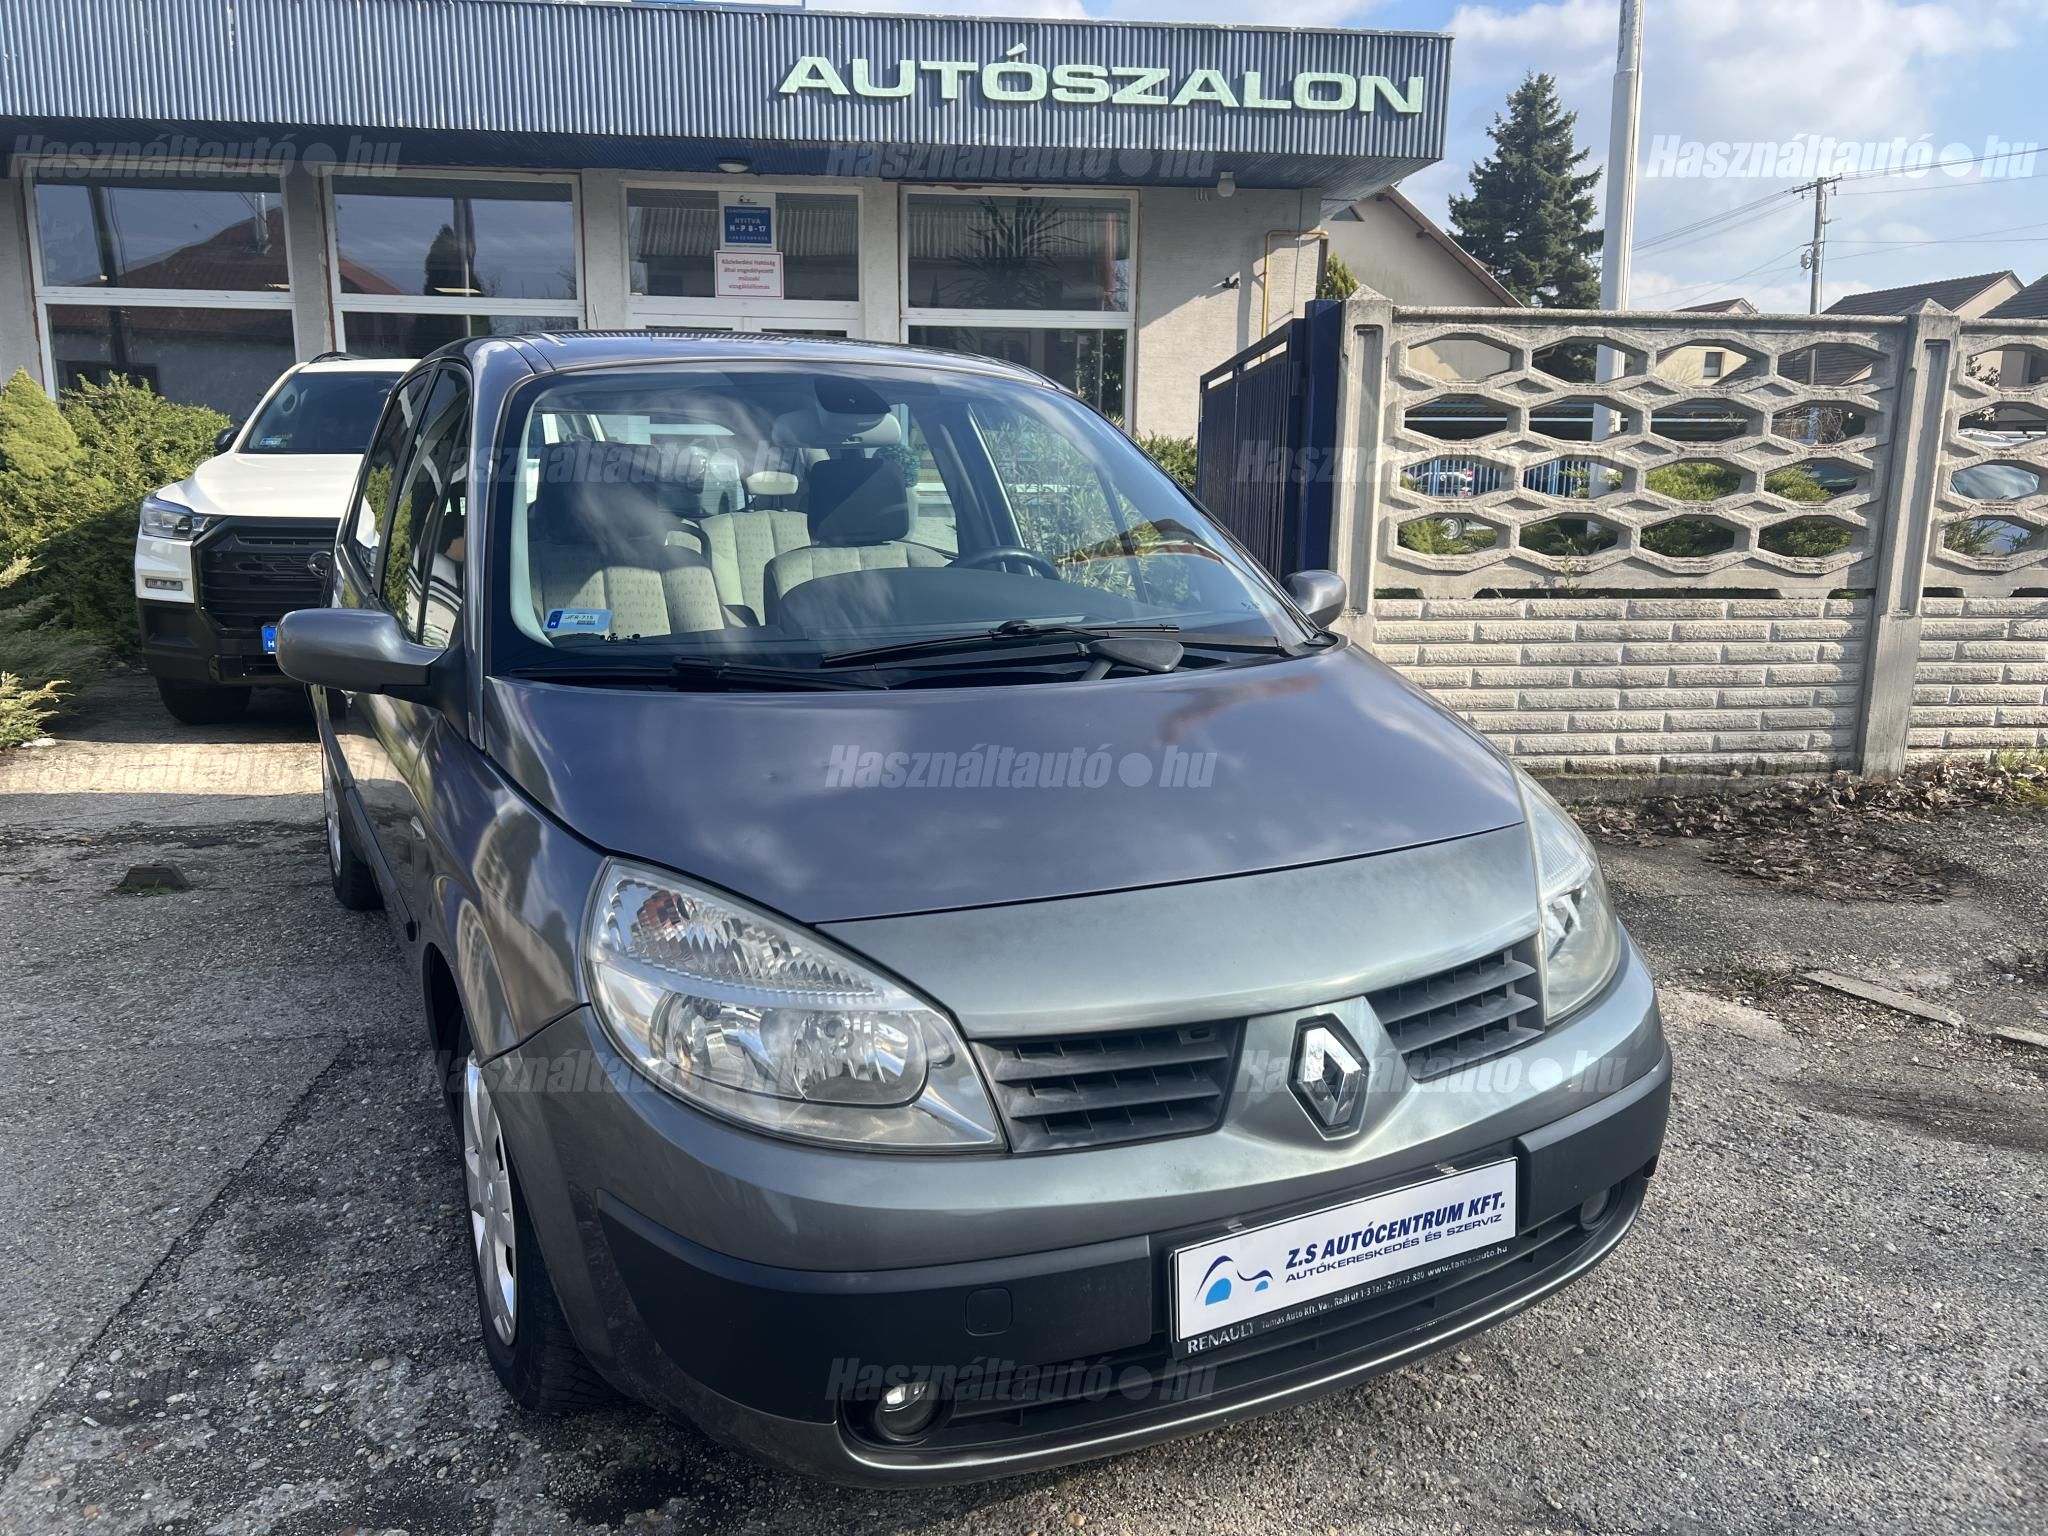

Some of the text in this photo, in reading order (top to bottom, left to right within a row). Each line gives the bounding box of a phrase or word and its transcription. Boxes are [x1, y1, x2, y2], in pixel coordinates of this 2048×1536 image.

[778, 42, 1424, 114] AUTÓSZALON
[267, 640, 275, 648] H
[1285, 1191, 1505, 1270] Z.S AUTÓCENTRUM KFT.
[1286, 1213, 1502, 1283] AUTÓKERESKEDÉS ÉS SZERVIZ
[1187, 1322, 1254, 1354] RENAULT
